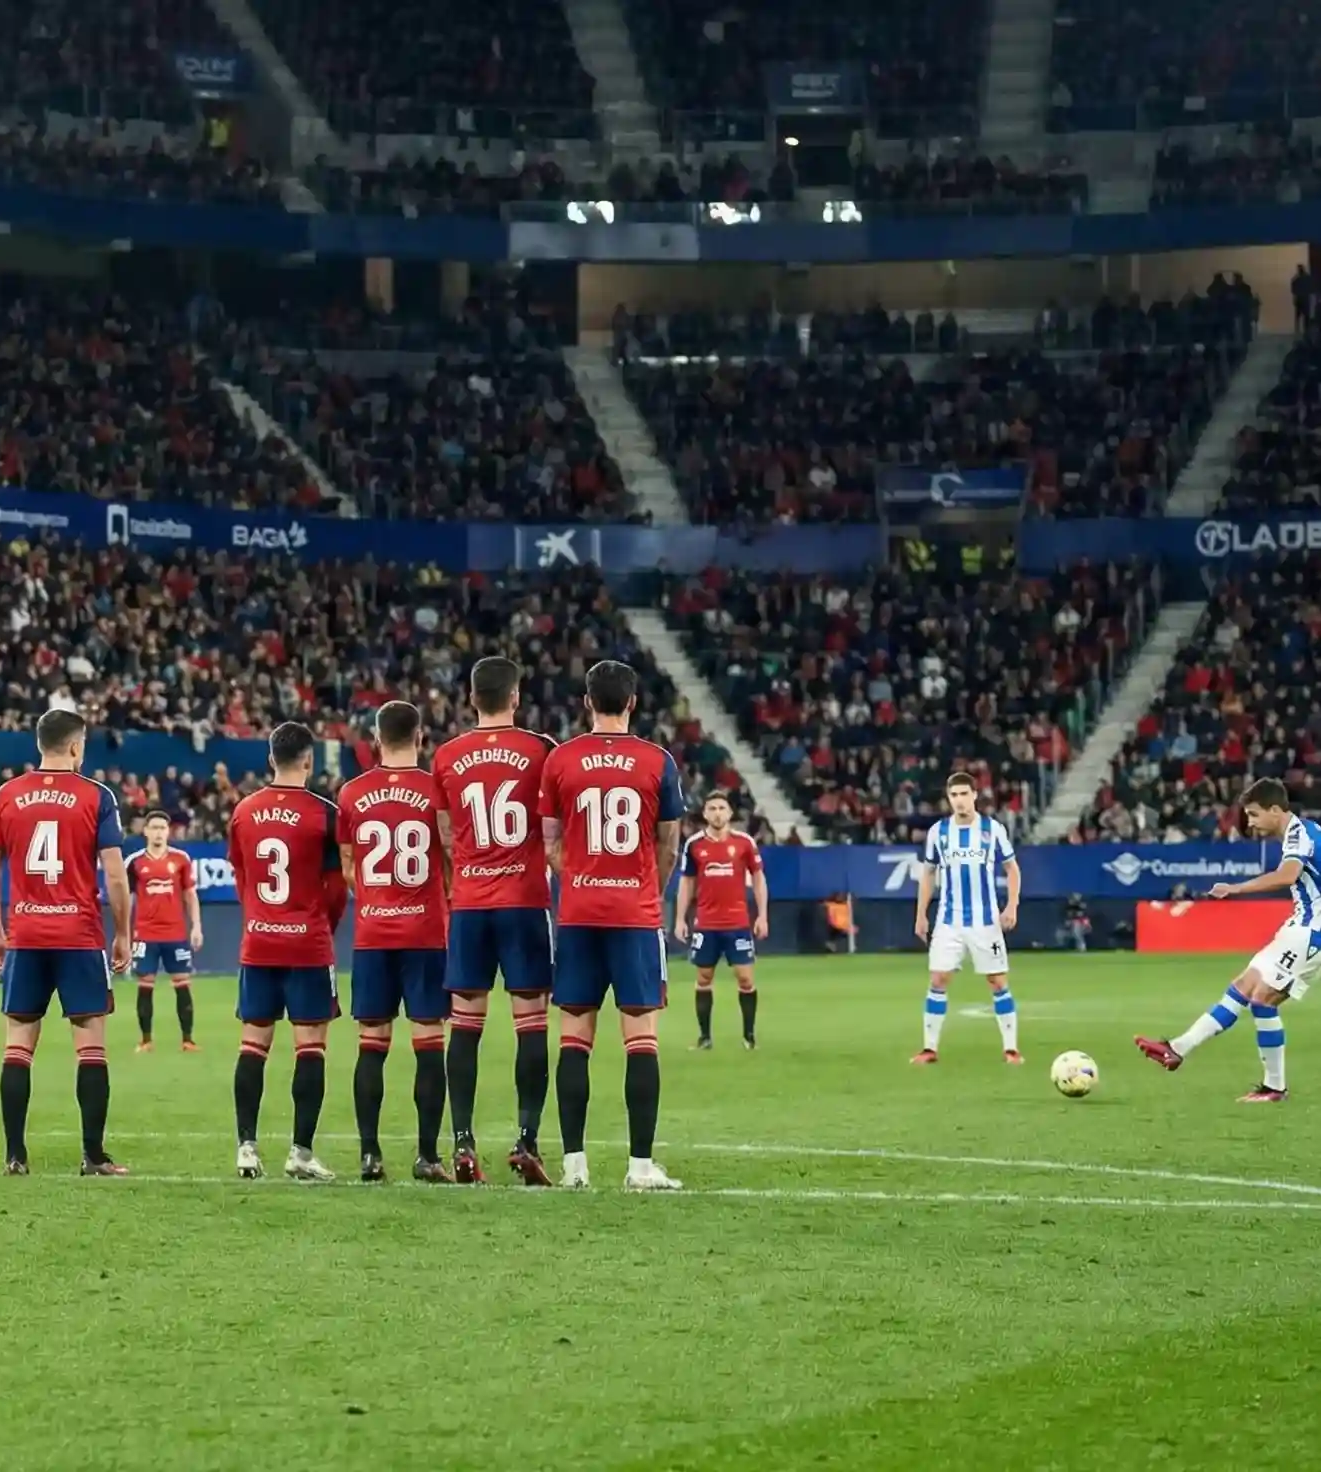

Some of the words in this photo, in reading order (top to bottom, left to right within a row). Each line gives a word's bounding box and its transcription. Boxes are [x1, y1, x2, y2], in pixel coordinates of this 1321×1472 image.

[461, 780, 527, 849] 16
[577, 787, 641, 855] 18
[25, 821, 63, 885] 4
[256, 837, 289, 905] 3
[356, 820, 431, 888] 28
